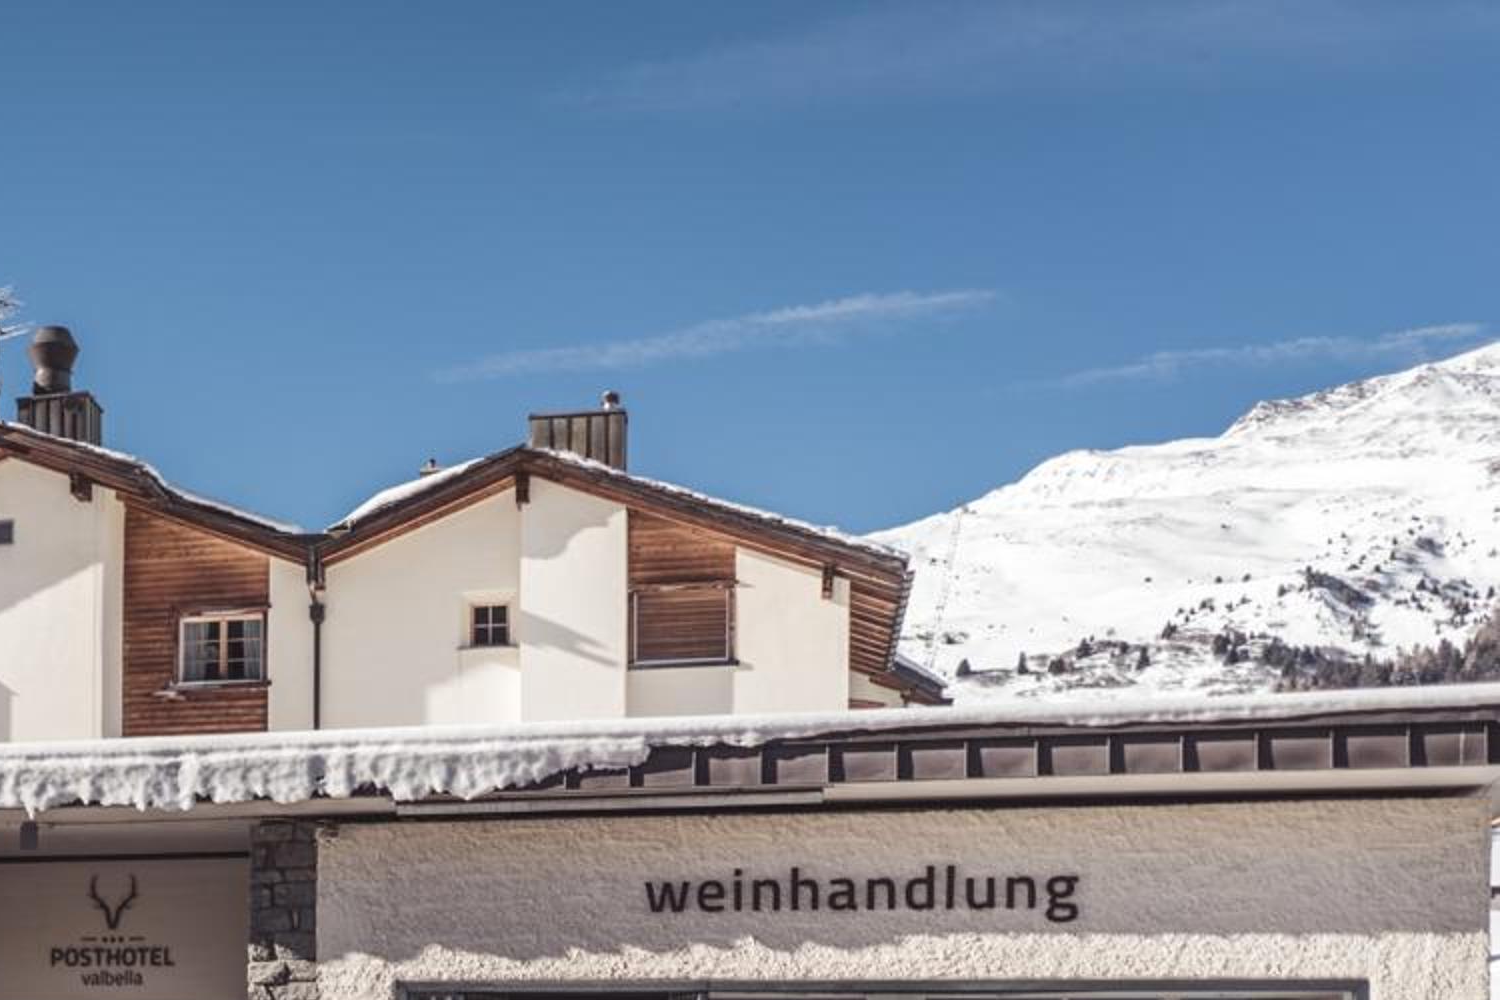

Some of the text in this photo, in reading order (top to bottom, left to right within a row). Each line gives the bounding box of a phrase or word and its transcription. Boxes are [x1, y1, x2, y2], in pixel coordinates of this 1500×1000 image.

[645, 866, 1080, 923] weinhandlung
[51, 947, 175, 967] POSTHOTEL
[81, 969, 143, 986] valbella
